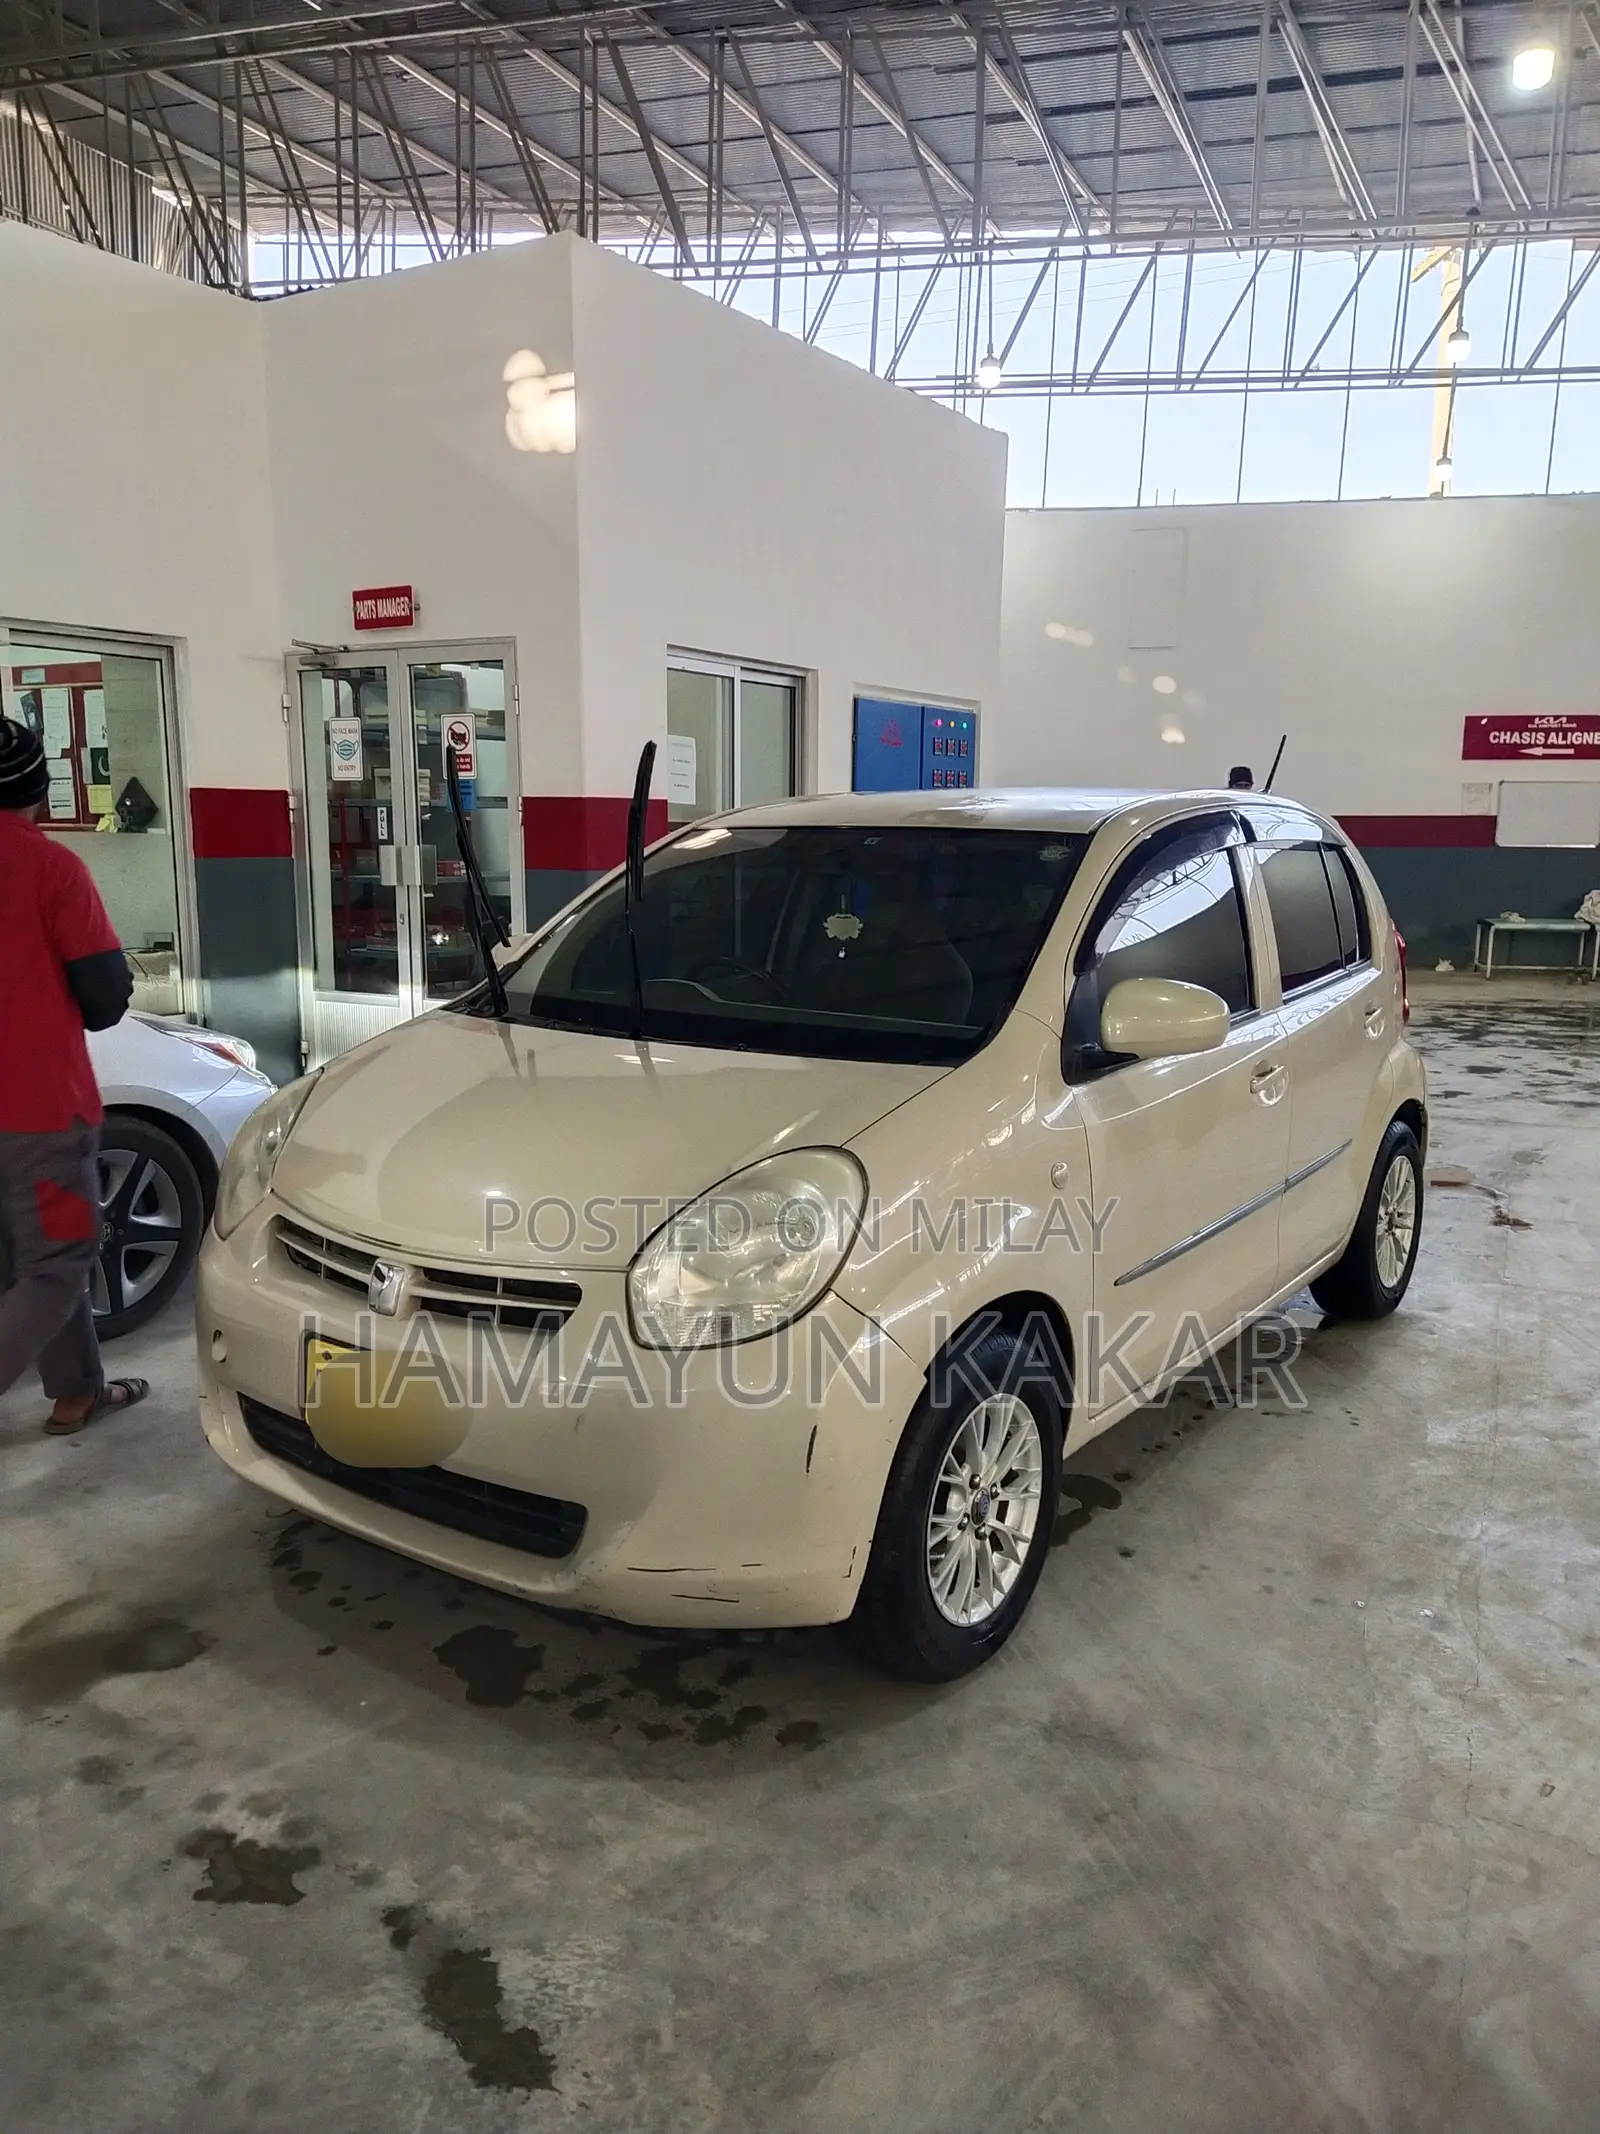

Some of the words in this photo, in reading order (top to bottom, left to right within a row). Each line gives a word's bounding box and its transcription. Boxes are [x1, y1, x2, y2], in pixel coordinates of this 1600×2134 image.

[356, 599, 376, 620] PARTS
[377, 596, 410, 618] MANAGER
[338, 727, 348, 735] FACE
[1489, 731, 1546, 744] CHASIS
[344, 764, 356, 772] ENTRY
